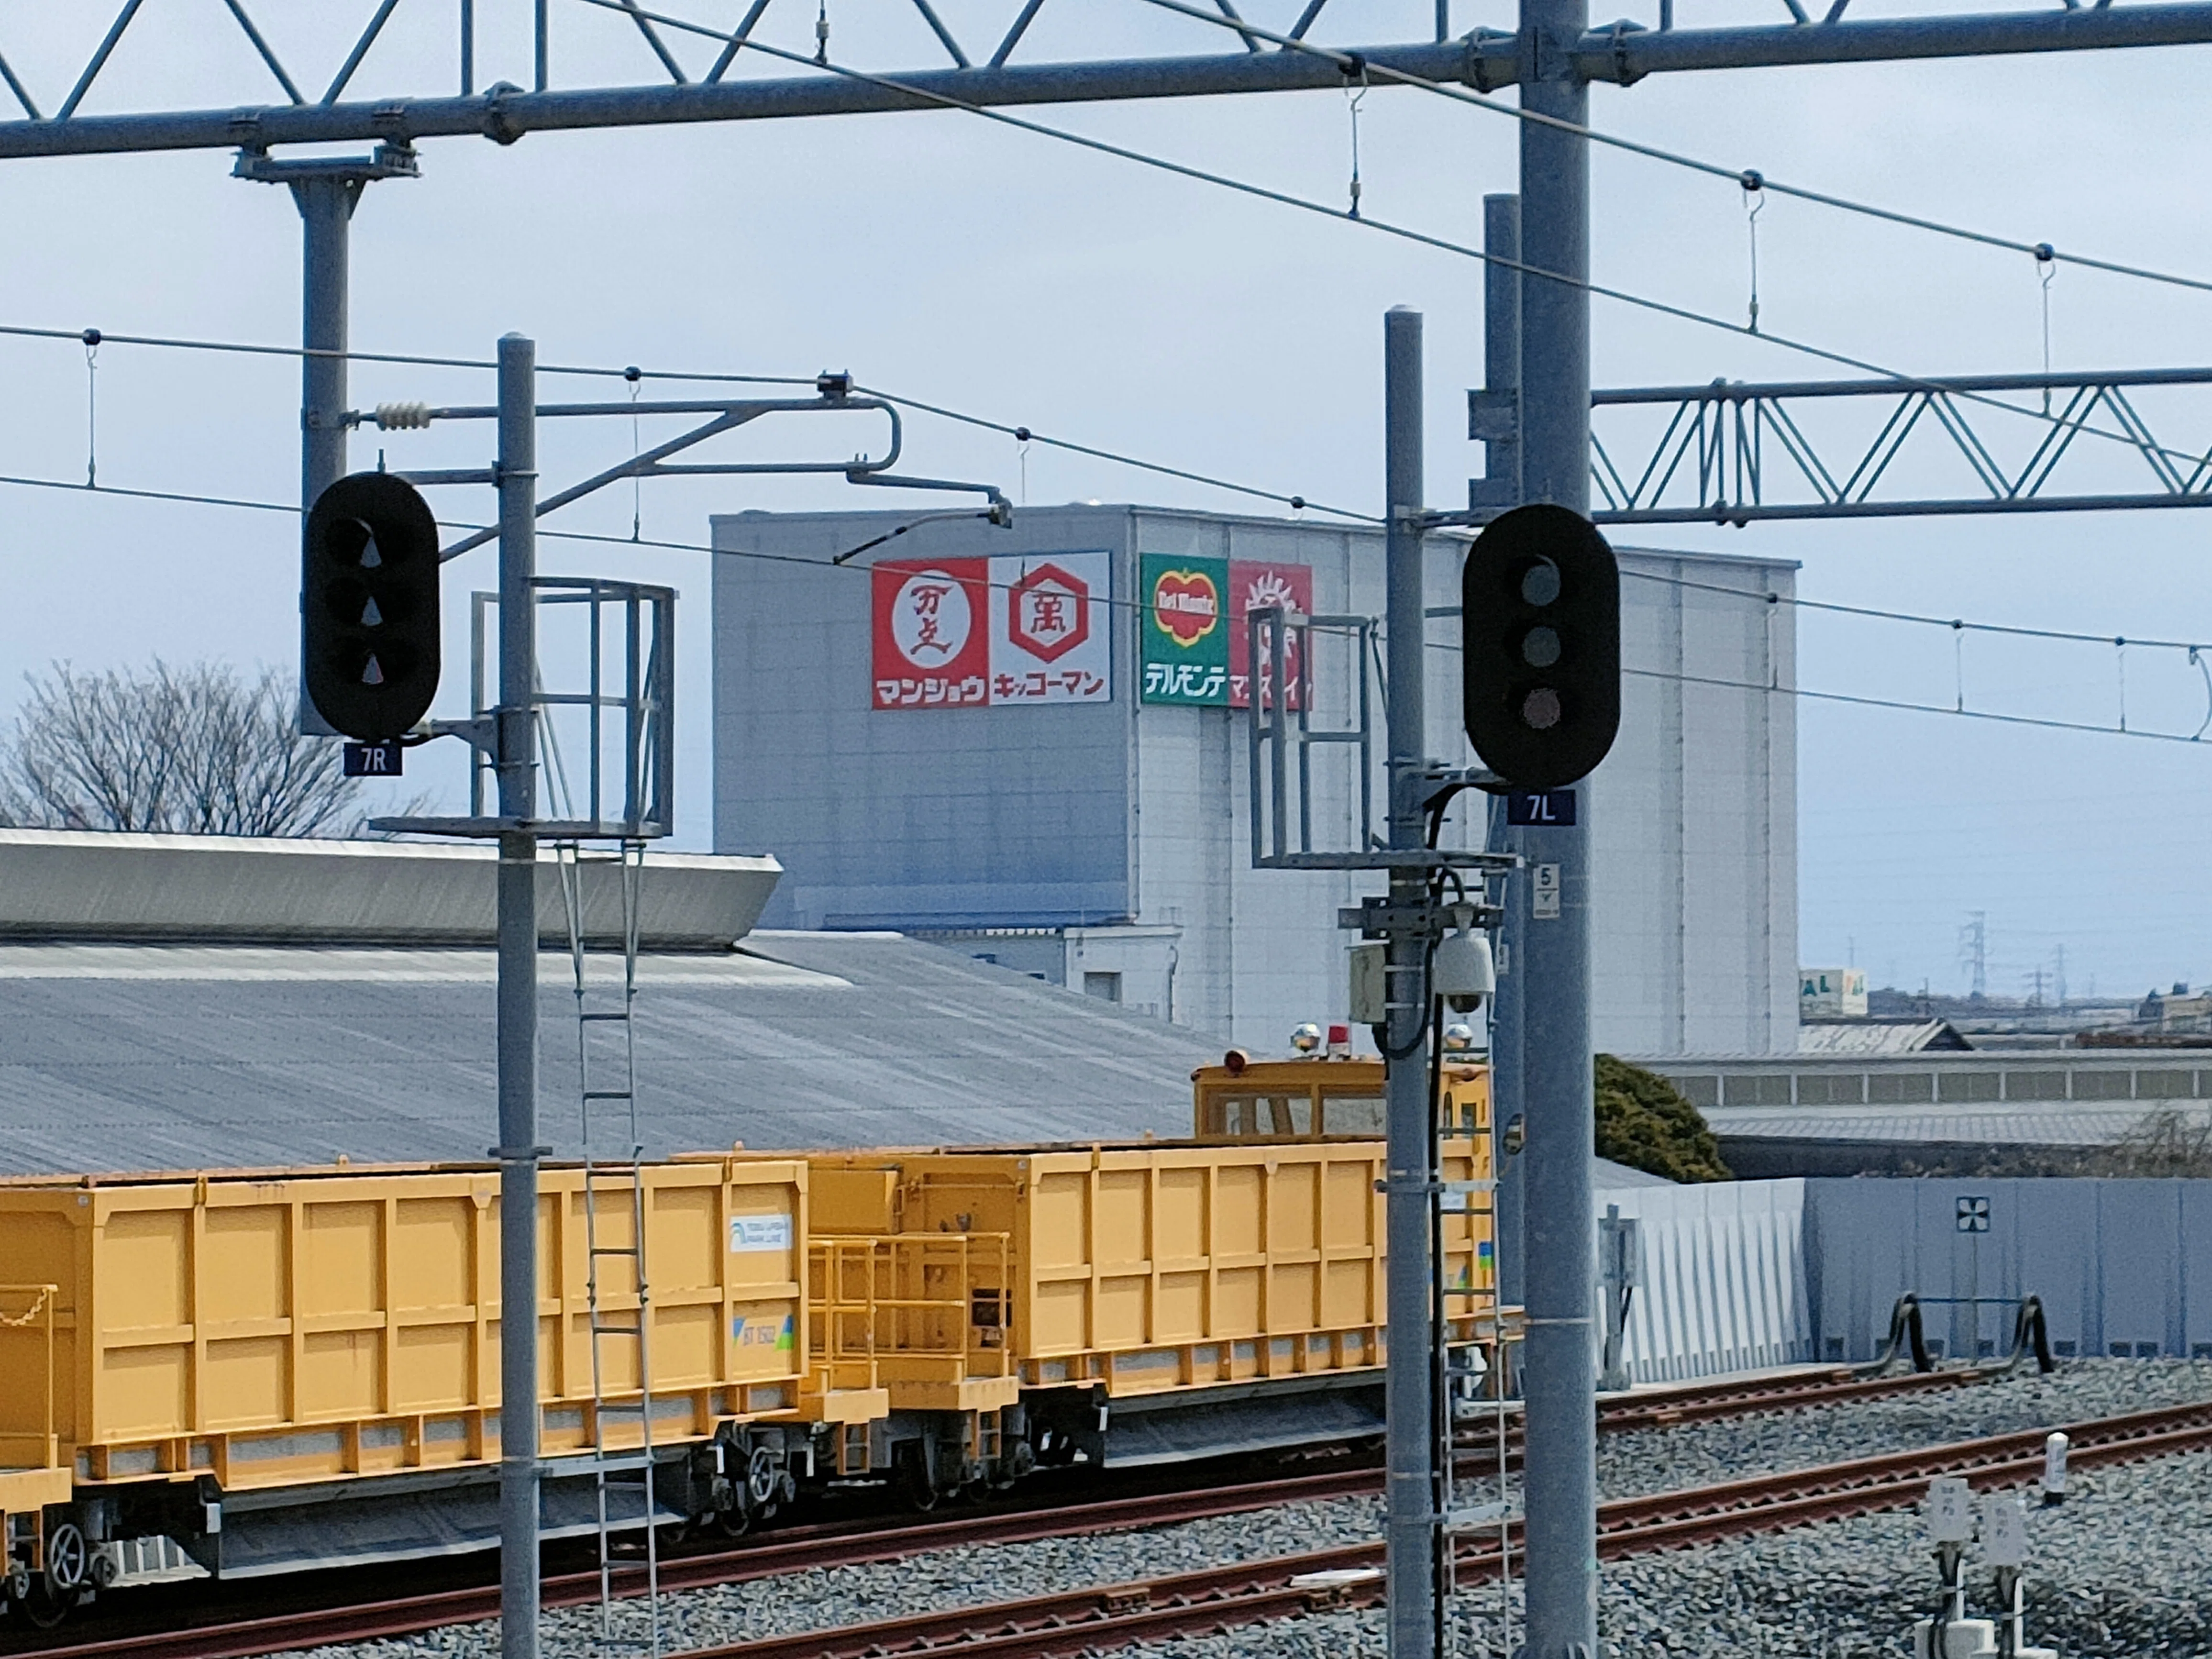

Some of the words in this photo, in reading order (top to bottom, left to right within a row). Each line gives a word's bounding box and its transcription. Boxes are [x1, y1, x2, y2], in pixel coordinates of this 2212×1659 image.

[876, 676, 984, 704] マンジョウ
[994, 671, 1104, 697] キッコーマン
[361, 748, 387, 771] 7R
[1527, 795, 1556, 820] 7L
[1541, 867, 1551, 885] 5
